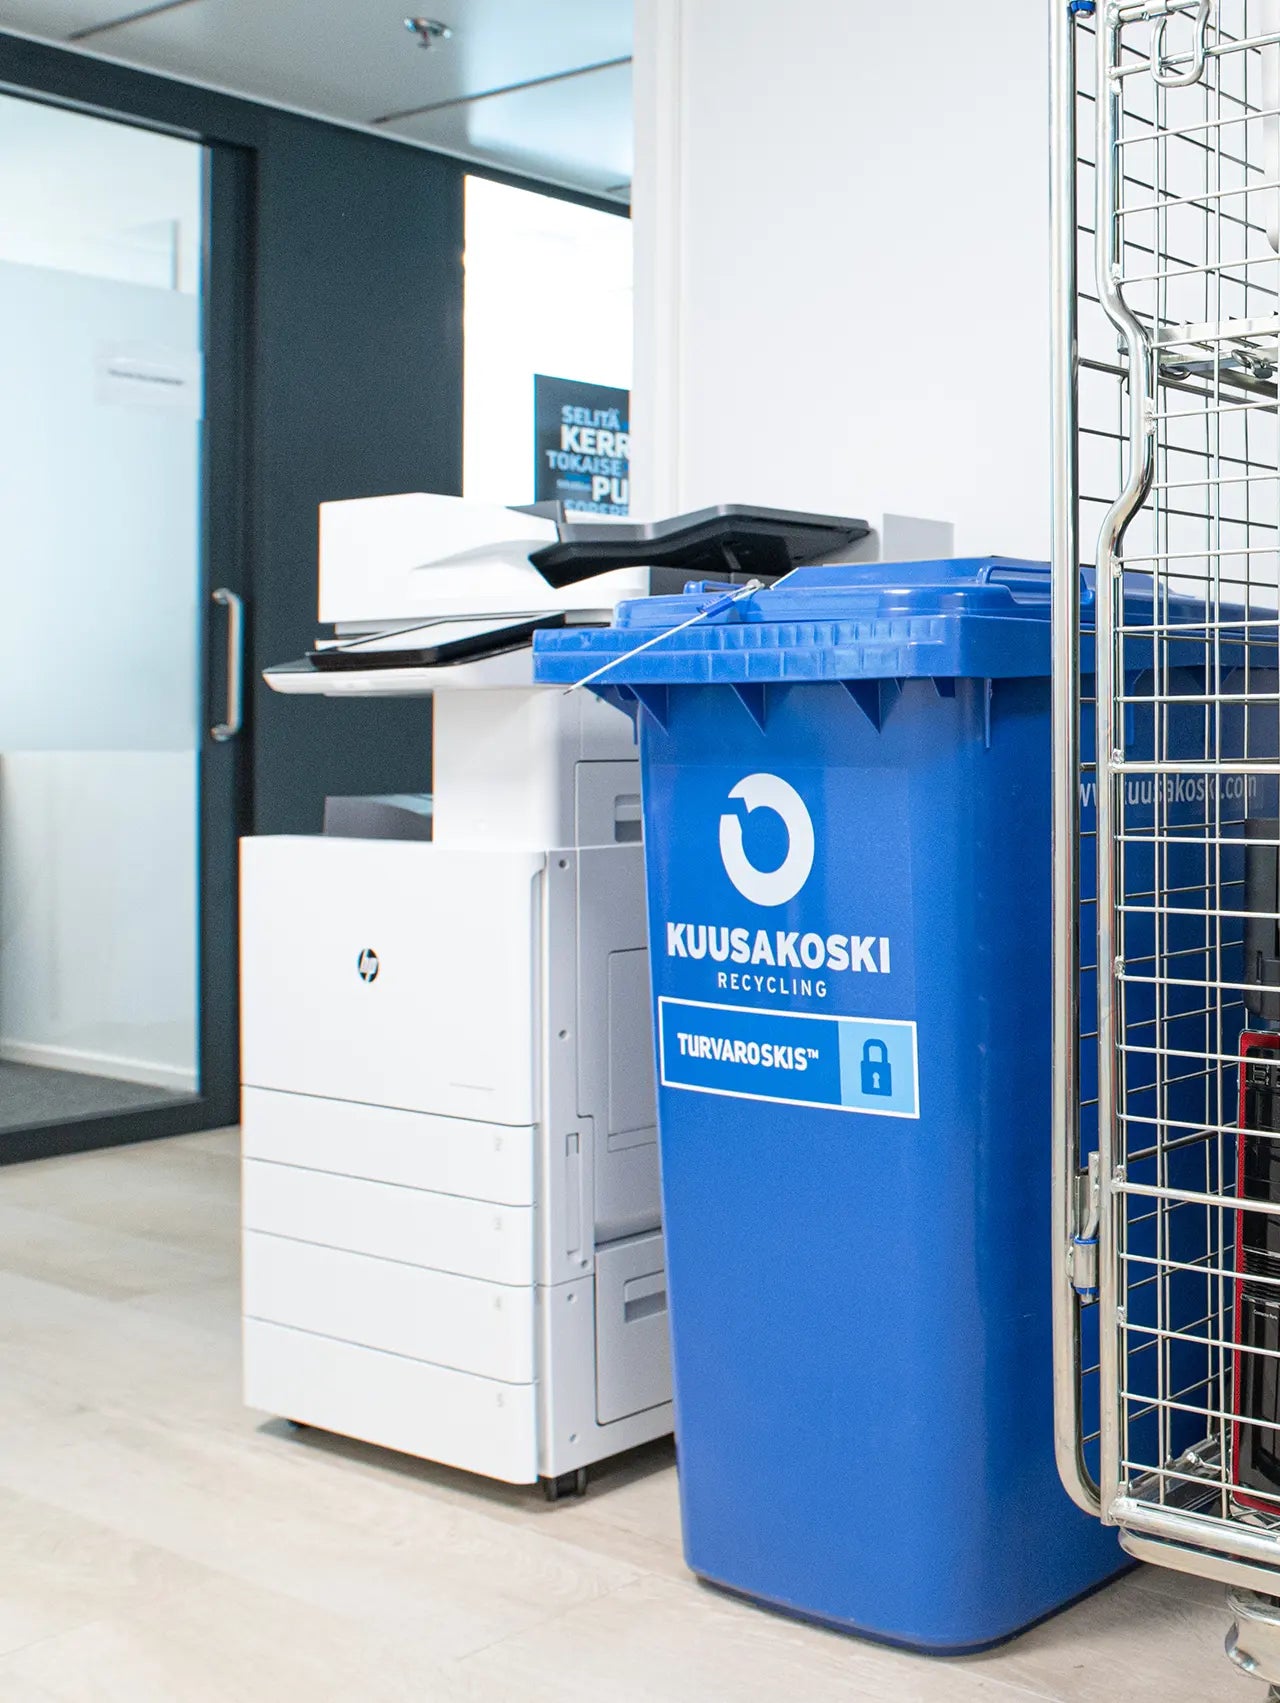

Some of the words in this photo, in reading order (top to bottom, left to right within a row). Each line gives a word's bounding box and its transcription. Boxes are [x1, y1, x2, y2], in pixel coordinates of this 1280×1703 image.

[562, 405, 620, 430] SELITÄ
[560, 424, 630, 458] KERR
[546, 450, 622, 477] TOKAISE
[666, 922, 890, 974] KUUSAKOSKI
[718, 972, 827, 998] RECYCLING
